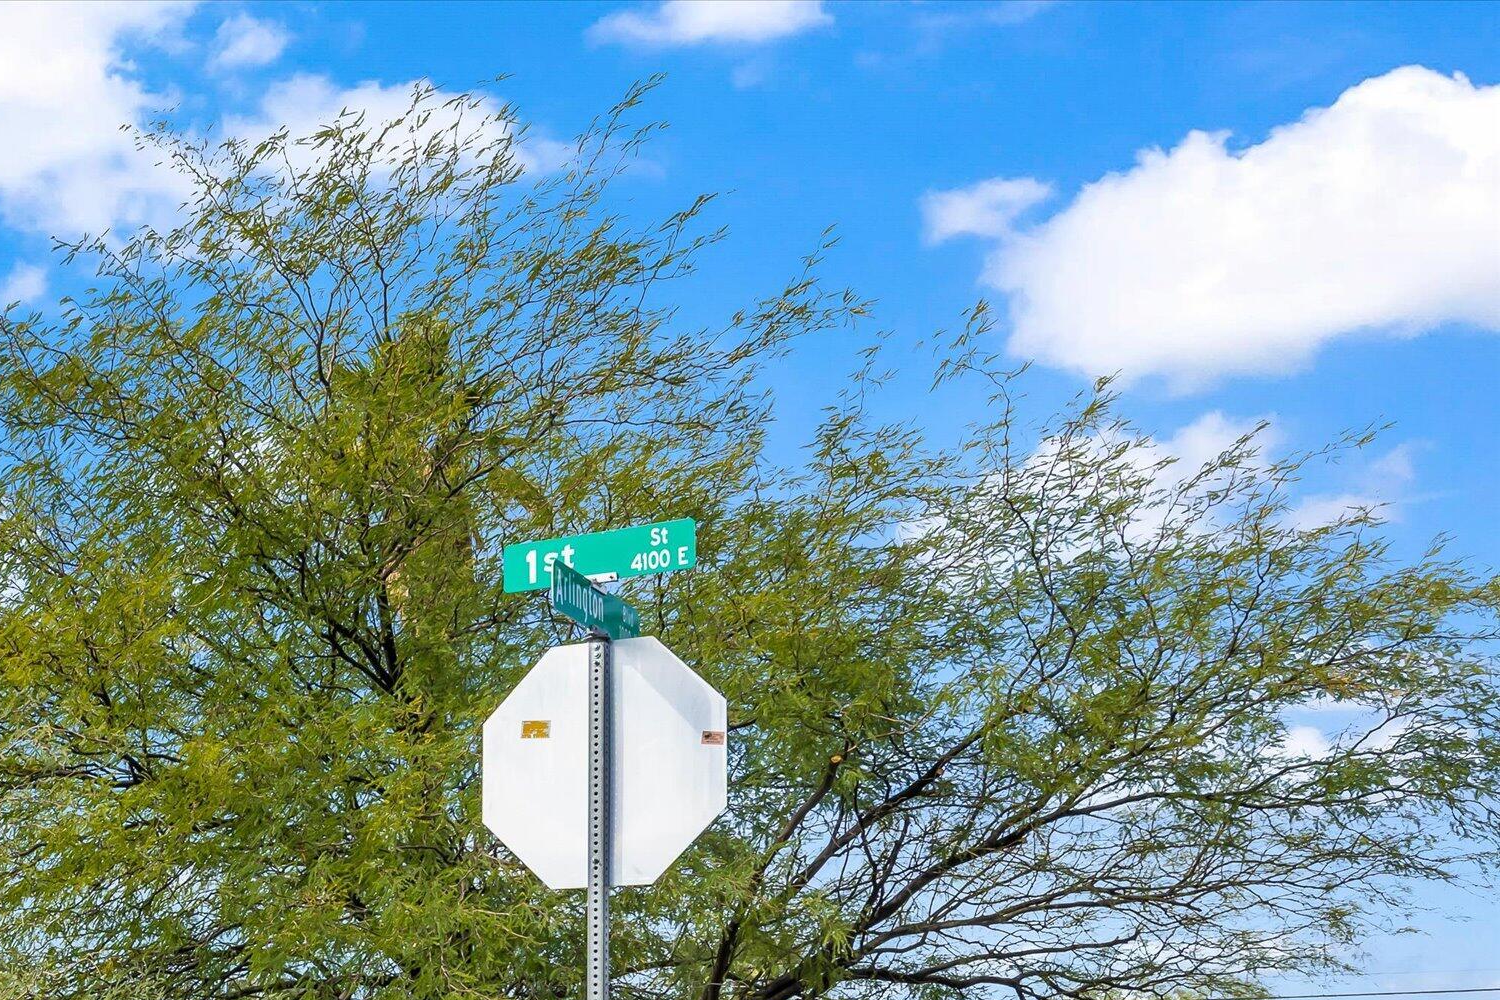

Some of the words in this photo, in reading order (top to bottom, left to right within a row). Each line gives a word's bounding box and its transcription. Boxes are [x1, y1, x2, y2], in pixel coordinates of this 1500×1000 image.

[650, 527, 669, 546] St
[525, 543, 575, 584] 1st
[631, 549, 671, 571] 4100
[678, 545, 689, 566] E
[556, 568, 604, 623] Arlington
